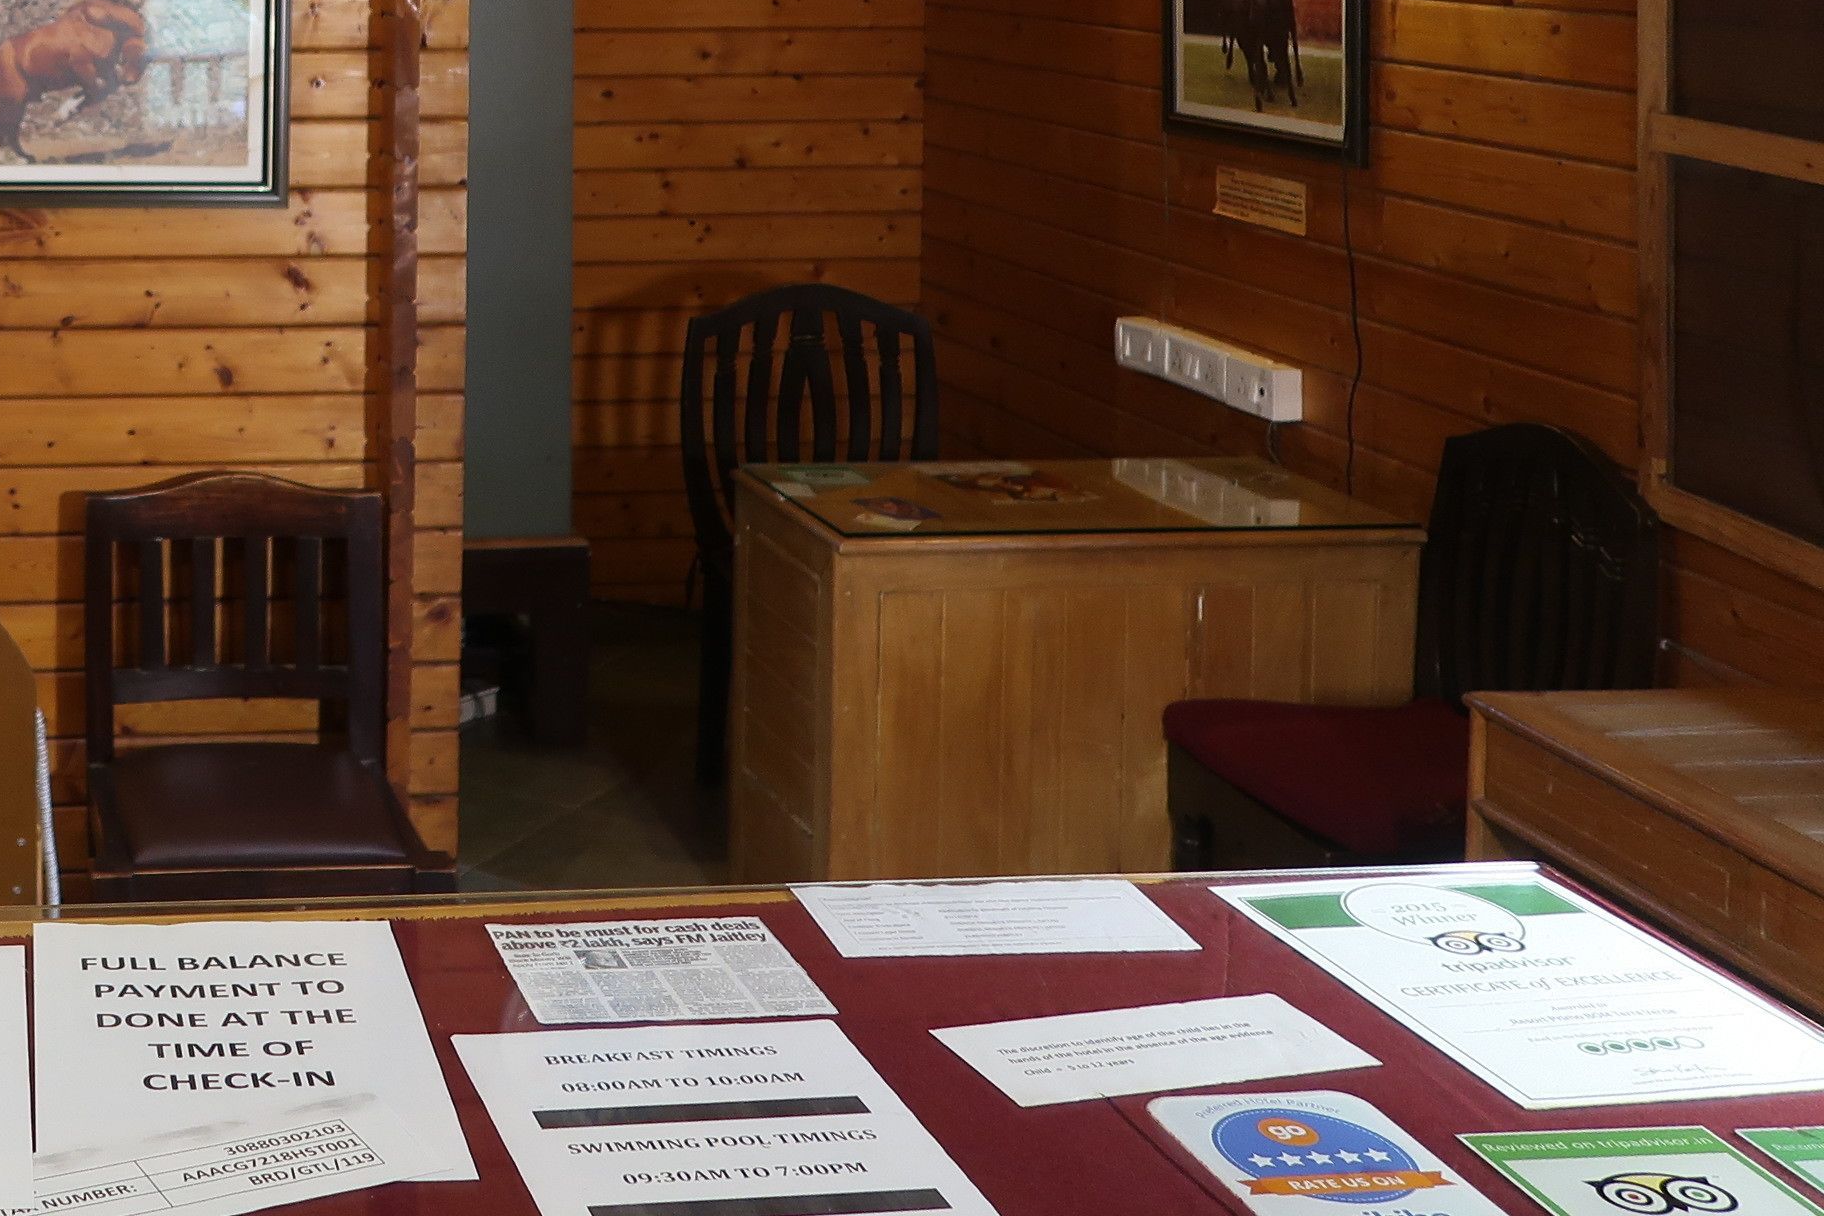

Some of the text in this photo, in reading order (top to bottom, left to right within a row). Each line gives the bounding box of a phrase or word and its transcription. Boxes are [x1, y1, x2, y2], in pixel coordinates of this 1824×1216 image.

[1391, 902, 1448, 914] 2015
[1390, 913, 1478, 926] Winner
[492, 921, 760, 940] PAN to be must for cash deals
[501, 940, 557, 951] above
[582, 937, 631, 948] lakh,
[631, 936, 675, 947] says
[675, 933, 707, 944] FM
[710, 932, 768, 943] Jaitley
[80, 952, 348, 972] FULL BALANCE
[1441, 956, 1576, 974] tripadvisor
[94, 979, 346, 999] PAYMENT TO
[1400, 970, 1684, 998] CERTIFICATE of EXCELLENCE
[96, 1008, 358, 1029] DONE AT THE
[997, 1048, 1019, 1056] The
[1019, 1041, 1070, 1054] discretion
[1084, 1035, 1125, 1046] identify
[1125, 1034, 1144, 1042] age
[1145, 1031, 1157, 1039] of
[1176, 1026, 1201, 1035] child
[1200, 1025, 1220, 1033] lies
[1220, 1023, 1232, 1031] in
[1233, 1021, 1252, 1029] the
[1007, 1030, 1275, 1065] hands of the hotel in the absence of the age evidence
[147, 1040, 316, 1059] TIME OF
[545, 1045, 779, 1067] BREAKFAST TIMINGS
[1023, 1066, 1053, 1076] Child
[1105, 1058, 1136, 1067] years
[142, 1070, 336, 1091] CHECK-IN
[560, 1072, 806, 1094] 08:00AM TO 10:00AM
[1243, 1097, 1281, 1106] Hotel
[1286, 1099, 1341, 1115] Partner
[223, 1124, 346, 1156] 30880302103
[567, 1129, 878, 1156] SWIMMING POOL TIMINGS
[1267, 1125, 1308, 1140] go
[1482, 1141, 1568, 1153] Reviewed
[1571, 1141, 1595, 1150] on
[182, 1138, 361, 1183] AAACG7218HST001
[248, 1152, 376, 1186] BRD/GTL/119
[622, 1161, 869, 1186] 09:30AM TO 7:00PM
[1288, 1176, 1406, 1191] RATE US ON
[40, 1184, 139, 1209] NUMBER:
